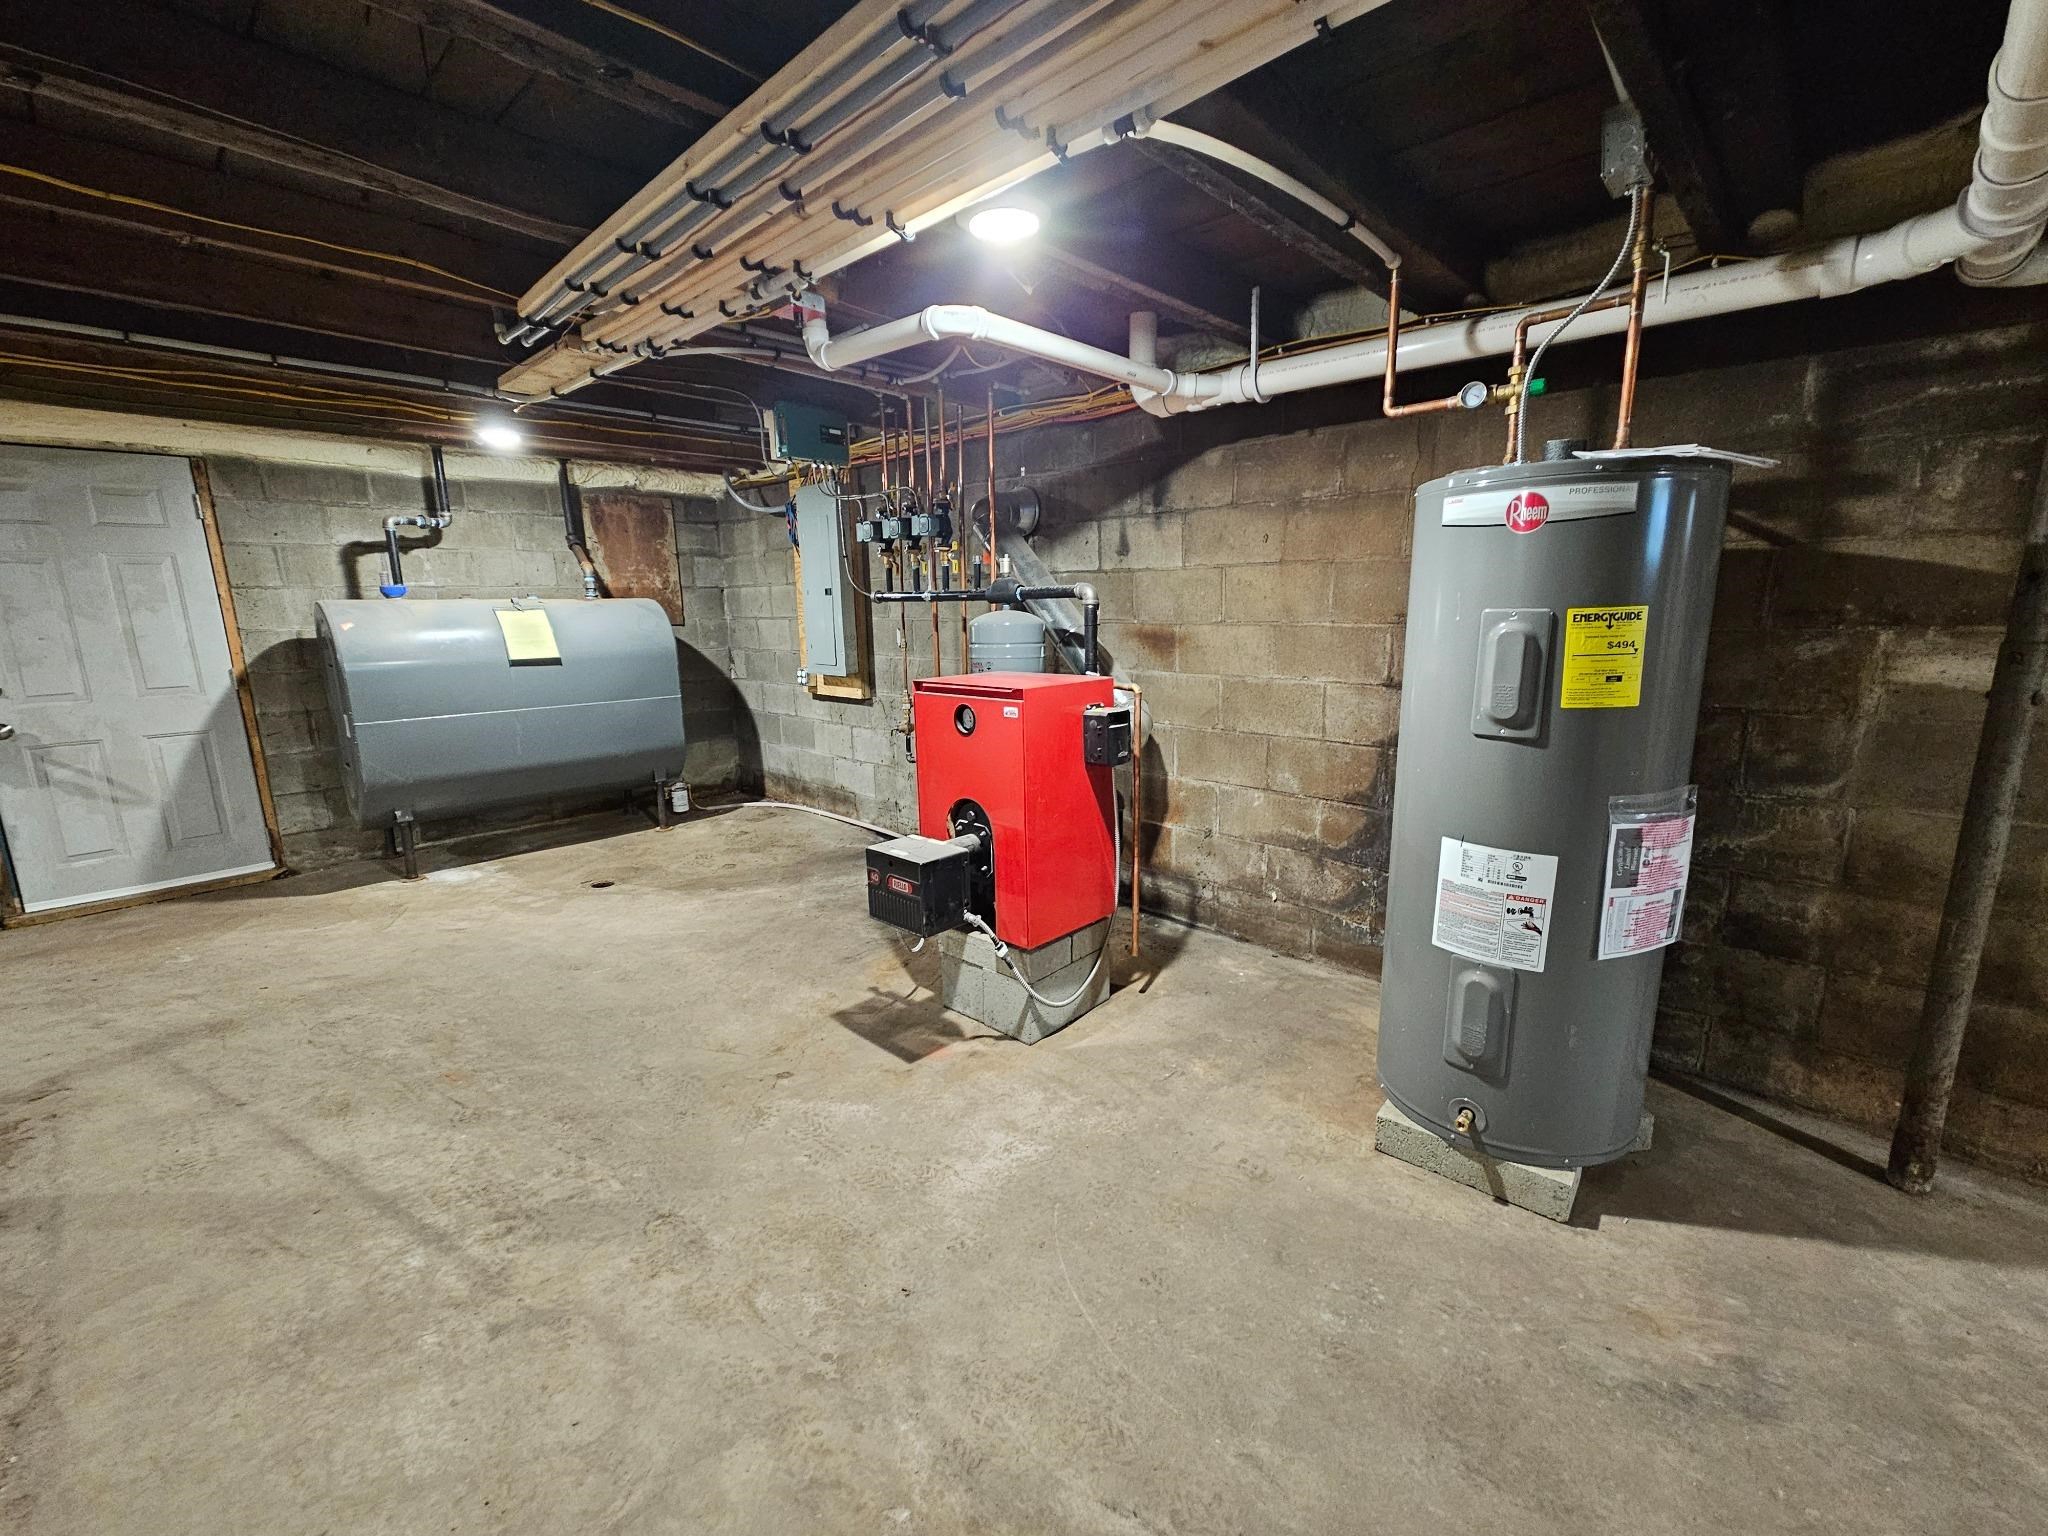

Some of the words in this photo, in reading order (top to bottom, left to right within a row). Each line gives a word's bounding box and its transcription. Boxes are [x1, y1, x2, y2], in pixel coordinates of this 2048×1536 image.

[1510, 499, 1548, 527] Rheem
[1572, 611, 1643, 624] ENERGYGUIDE
[1607, 640, 1635, 649] $494
[1515, 895, 1546, 904] DANGER
